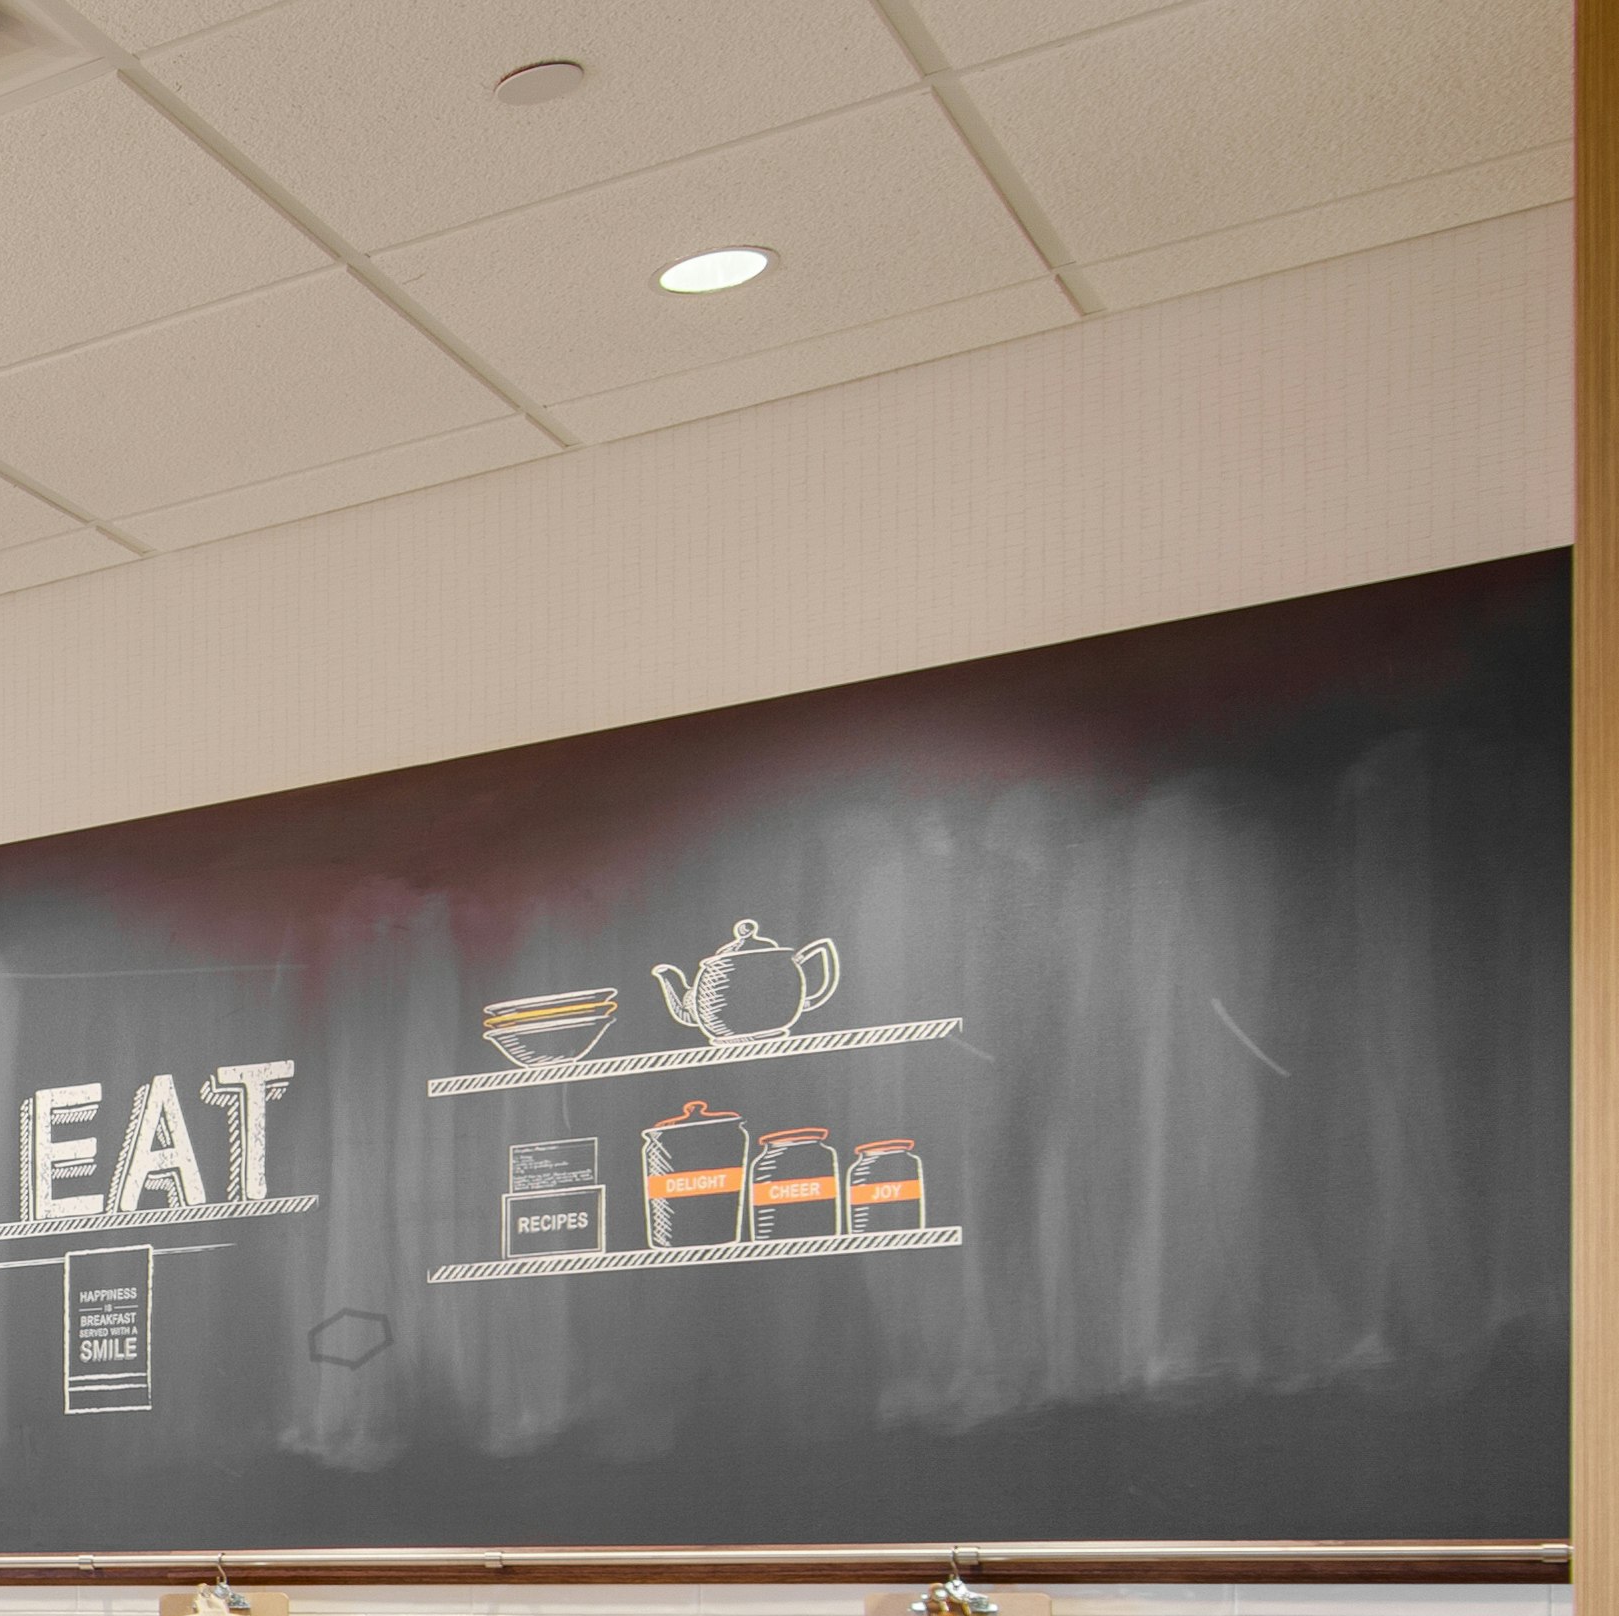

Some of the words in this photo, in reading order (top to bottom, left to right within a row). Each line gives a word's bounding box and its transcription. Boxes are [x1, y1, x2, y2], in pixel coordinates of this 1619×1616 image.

[19, 1059, 294, 1222] EAT
[665, 1174, 727, 1192] DELIGHT
[769, 1182, 820, 1199] CHEER
[871, 1184, 901, 1199] JOY
[517, 1212, 589, 1234] RECIPES
[79, 1287, 138, 1303] HAPPINESS
[104, 1303, 112, 1312] IS
[80, 1312, 136, 1327] BREAKFAST
[79, 1327, 109, 1338] SERVED
[110, 1326, 130, 1336] WITH
[131, 1326, 138, 1335] A
[79, 1337, 138, 1363] SMILE
